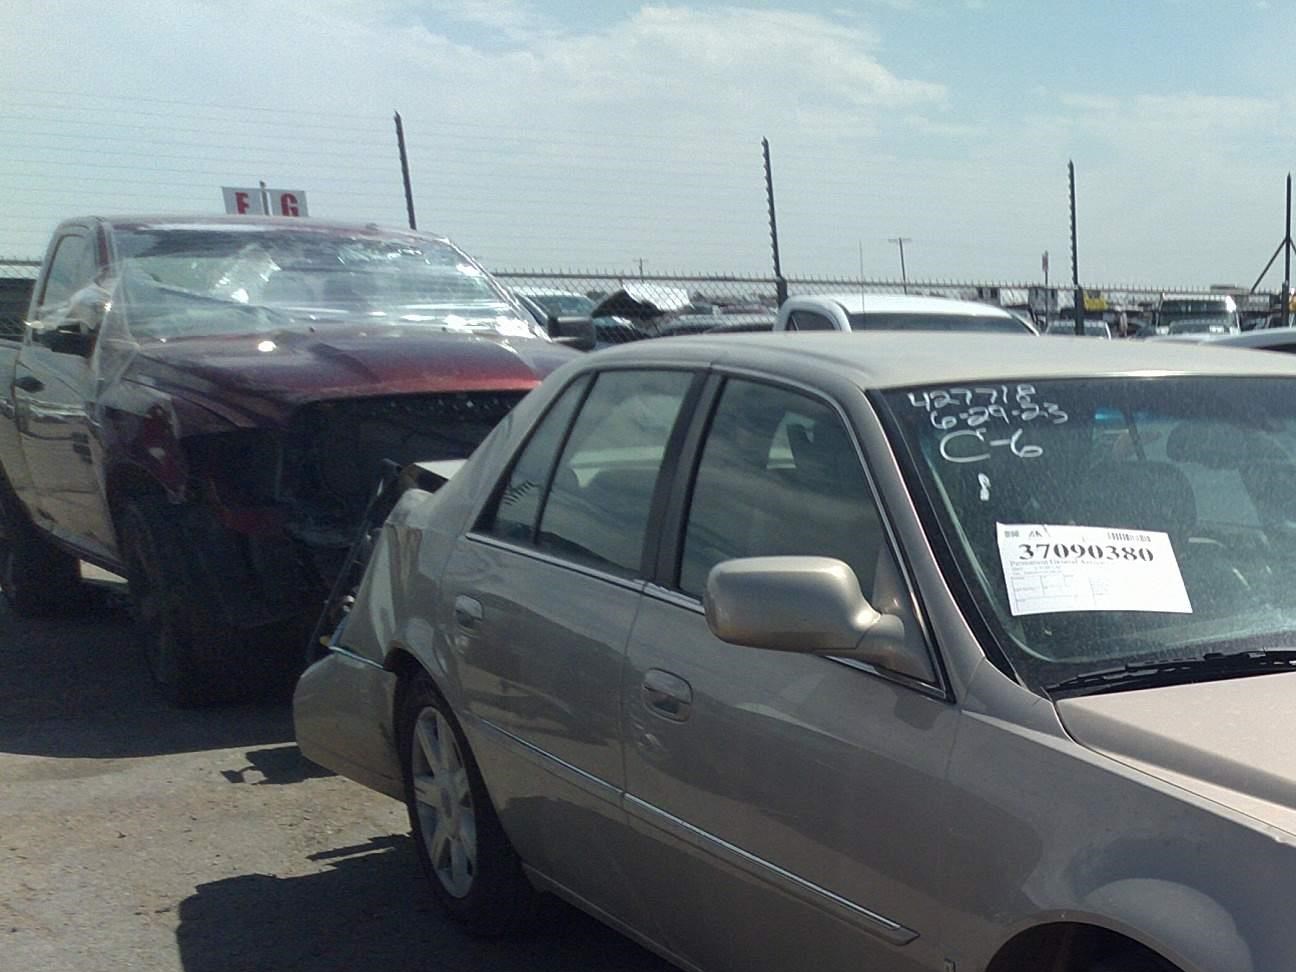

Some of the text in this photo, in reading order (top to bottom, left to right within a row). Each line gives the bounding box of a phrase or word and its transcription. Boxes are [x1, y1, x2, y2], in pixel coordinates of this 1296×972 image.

[280, 192, 299, 217] G
[907, 384, 1036, 412] 427718
[939, 427, 1044, 463] C-6
[1018, 543, 1155, 562] 37090380
